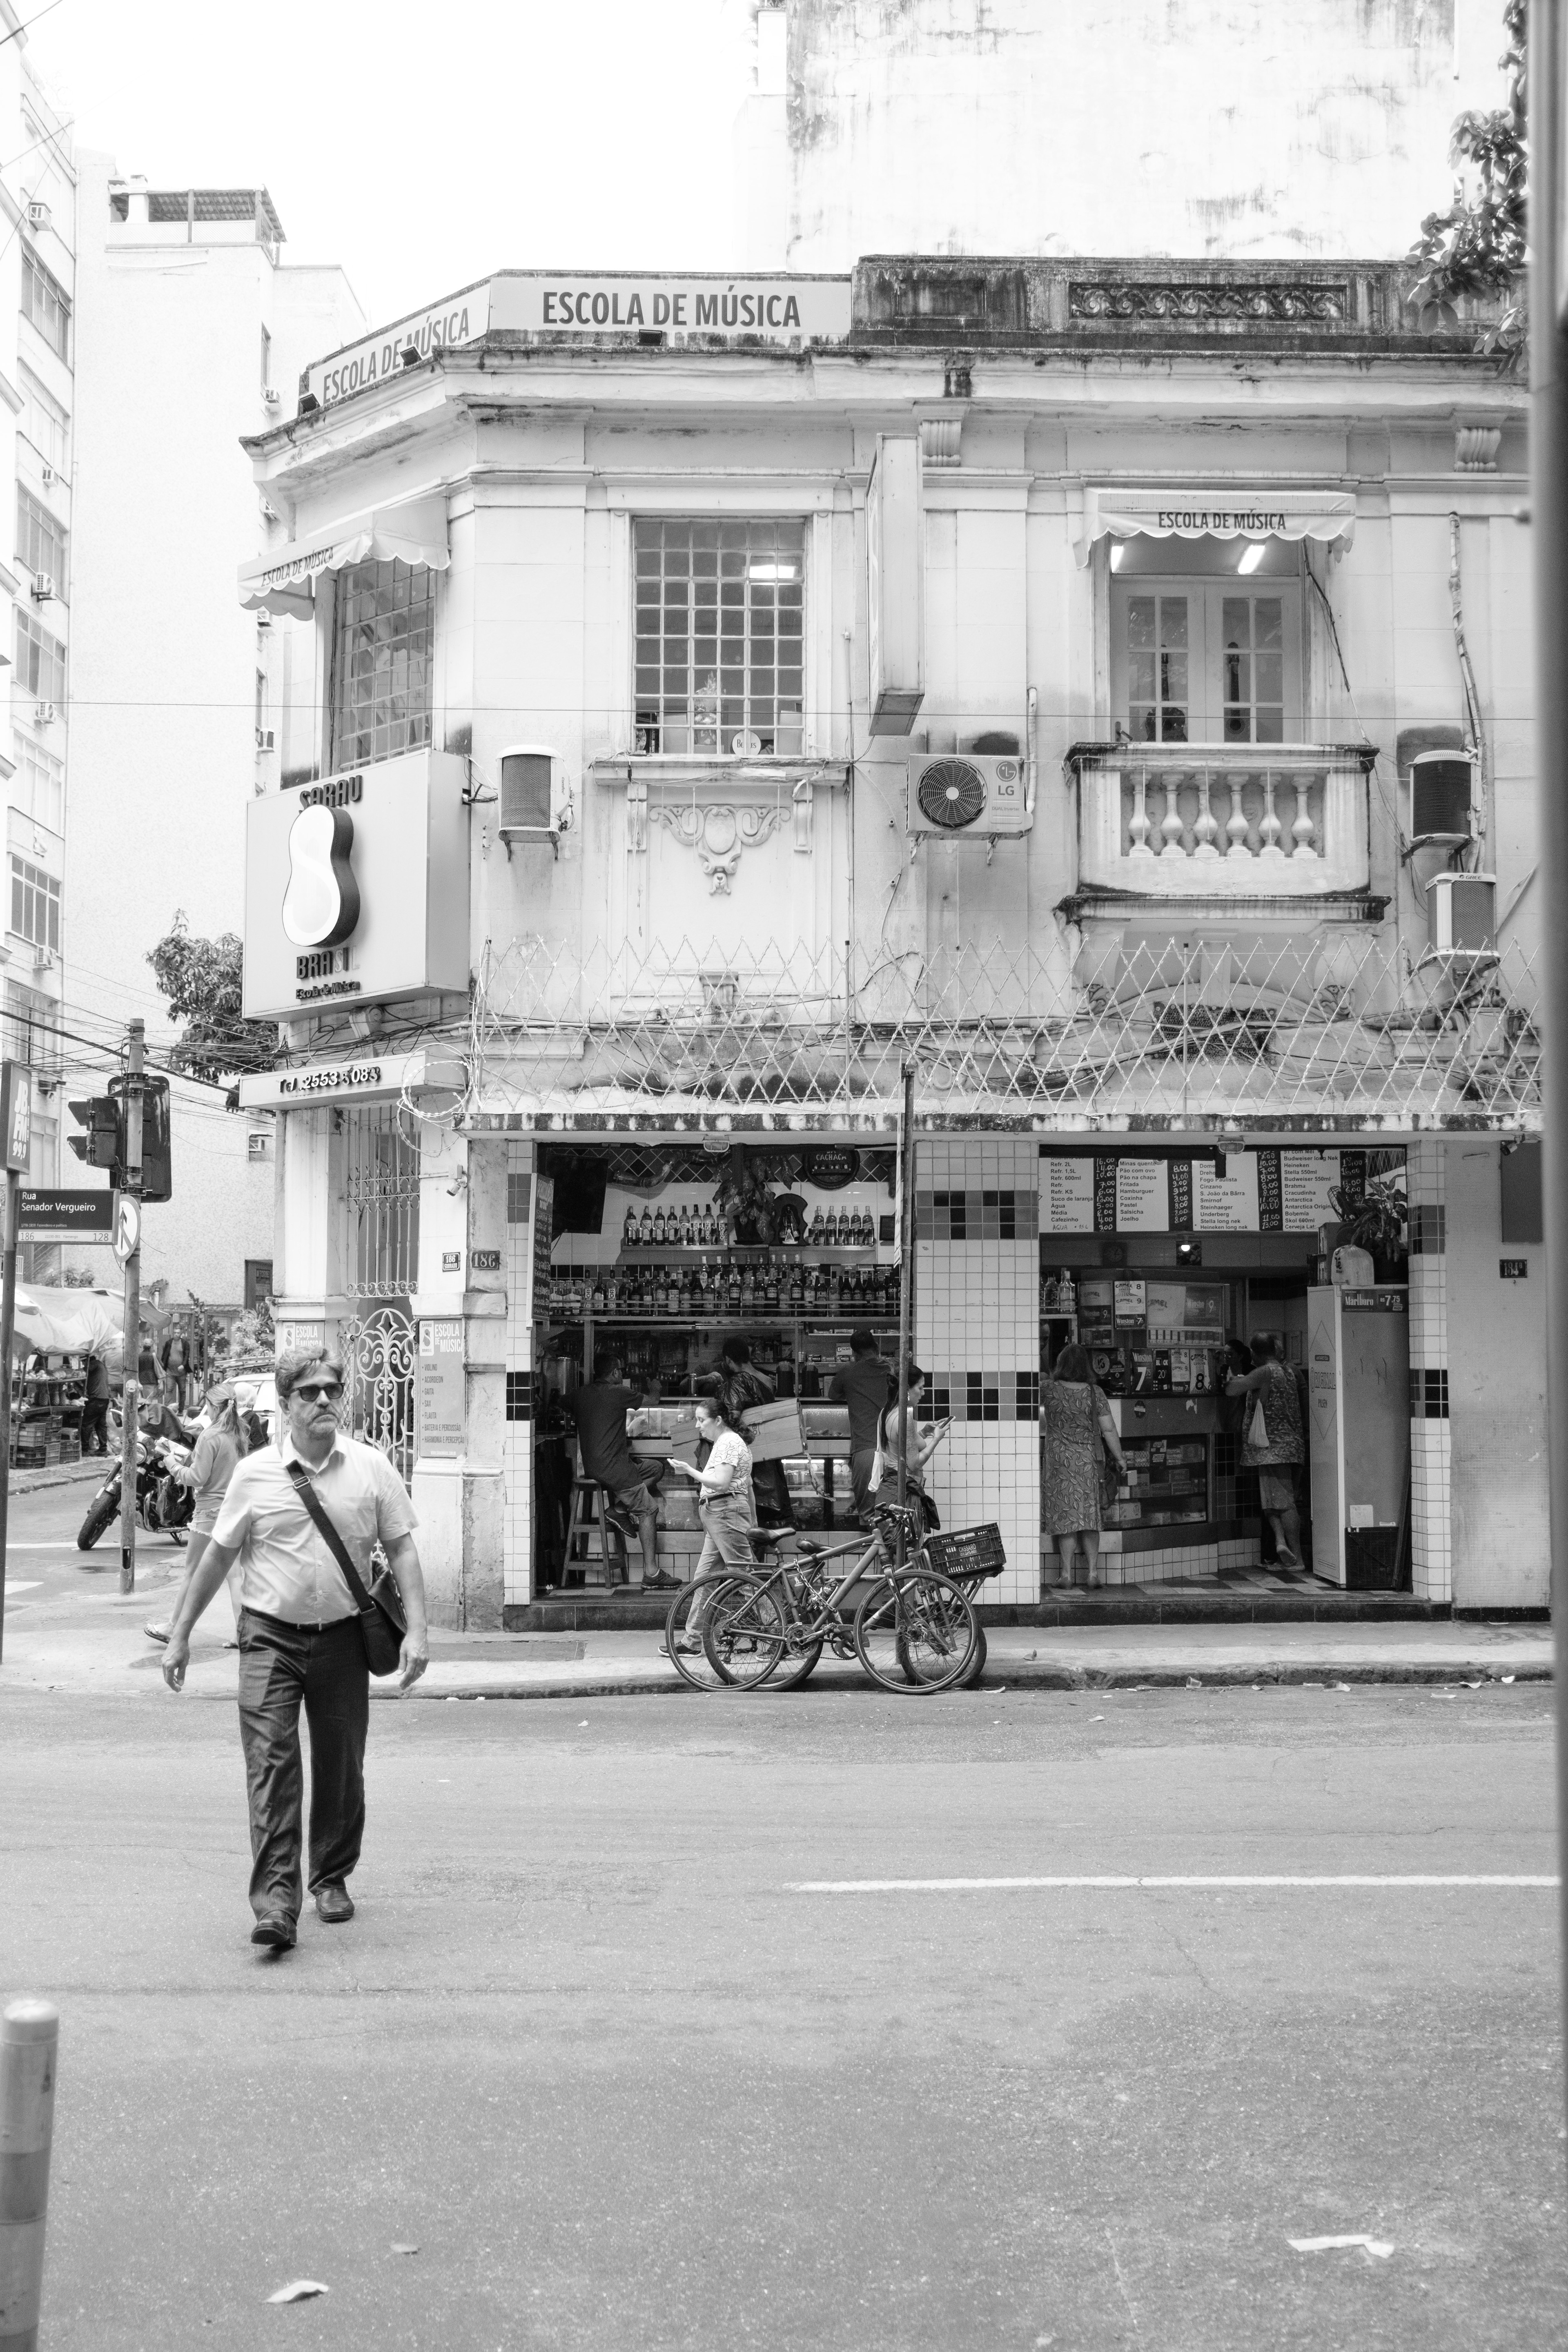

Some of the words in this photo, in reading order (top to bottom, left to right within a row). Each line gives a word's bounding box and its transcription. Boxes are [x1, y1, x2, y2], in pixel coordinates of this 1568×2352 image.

[543, 292, 645, 325] ESCOLA
[653, 293, 687, 325] DE
[696, 285, 801, 327] MÚSICA
[323, 351, 377, 405] ESCOLA
[381, 338, 403, 376] DE
[1158, 512, 1209, 528] ESCOLA
[1212, 512, 1230, 529] DE
[1234, 509, 1286, 530] MÚSICA
[261, 564, 290, 587] ESCOLA
[292, 559, 303, 577] DE
[304, 547, 333, 572] MÚSICA
[298, 775, 362, 814] SARAU
[998, 785, 1014, 796] LG
[296, 946, 361, 979] BRASIL
[296, 986, 318, 999] Escola
[320, 984, 329, 995] de
[14, 1080, 28, 1116] JB
[13, 1113, 28, 1143] FM
[12, 1140, 27, 1160] 99,9
[21, 1202, 53, 1211] Senador
[55, 1203, 96, 1213] Vergueiro
[20, 1232, 34, 1241] 186
[93, 1233, 109, 1241] 128
[446, 1255, 456, 1263] 186
[474, 1253, 495, 1267] 186
[1345, 1294, 1373, 1305] Marlboro
[296, 1325, 318, 1338] ESCOLA
[434, 1323, 459, 1337] ESCOLA
[1132, 1352, 1152, 1362] Winston
[442, 1423, 461, 1431] PERCUSSÃO
[445, 1435, 464, 1445] PERCEPÇÃO
[958, 1543, 976, 1552] CASSARO
